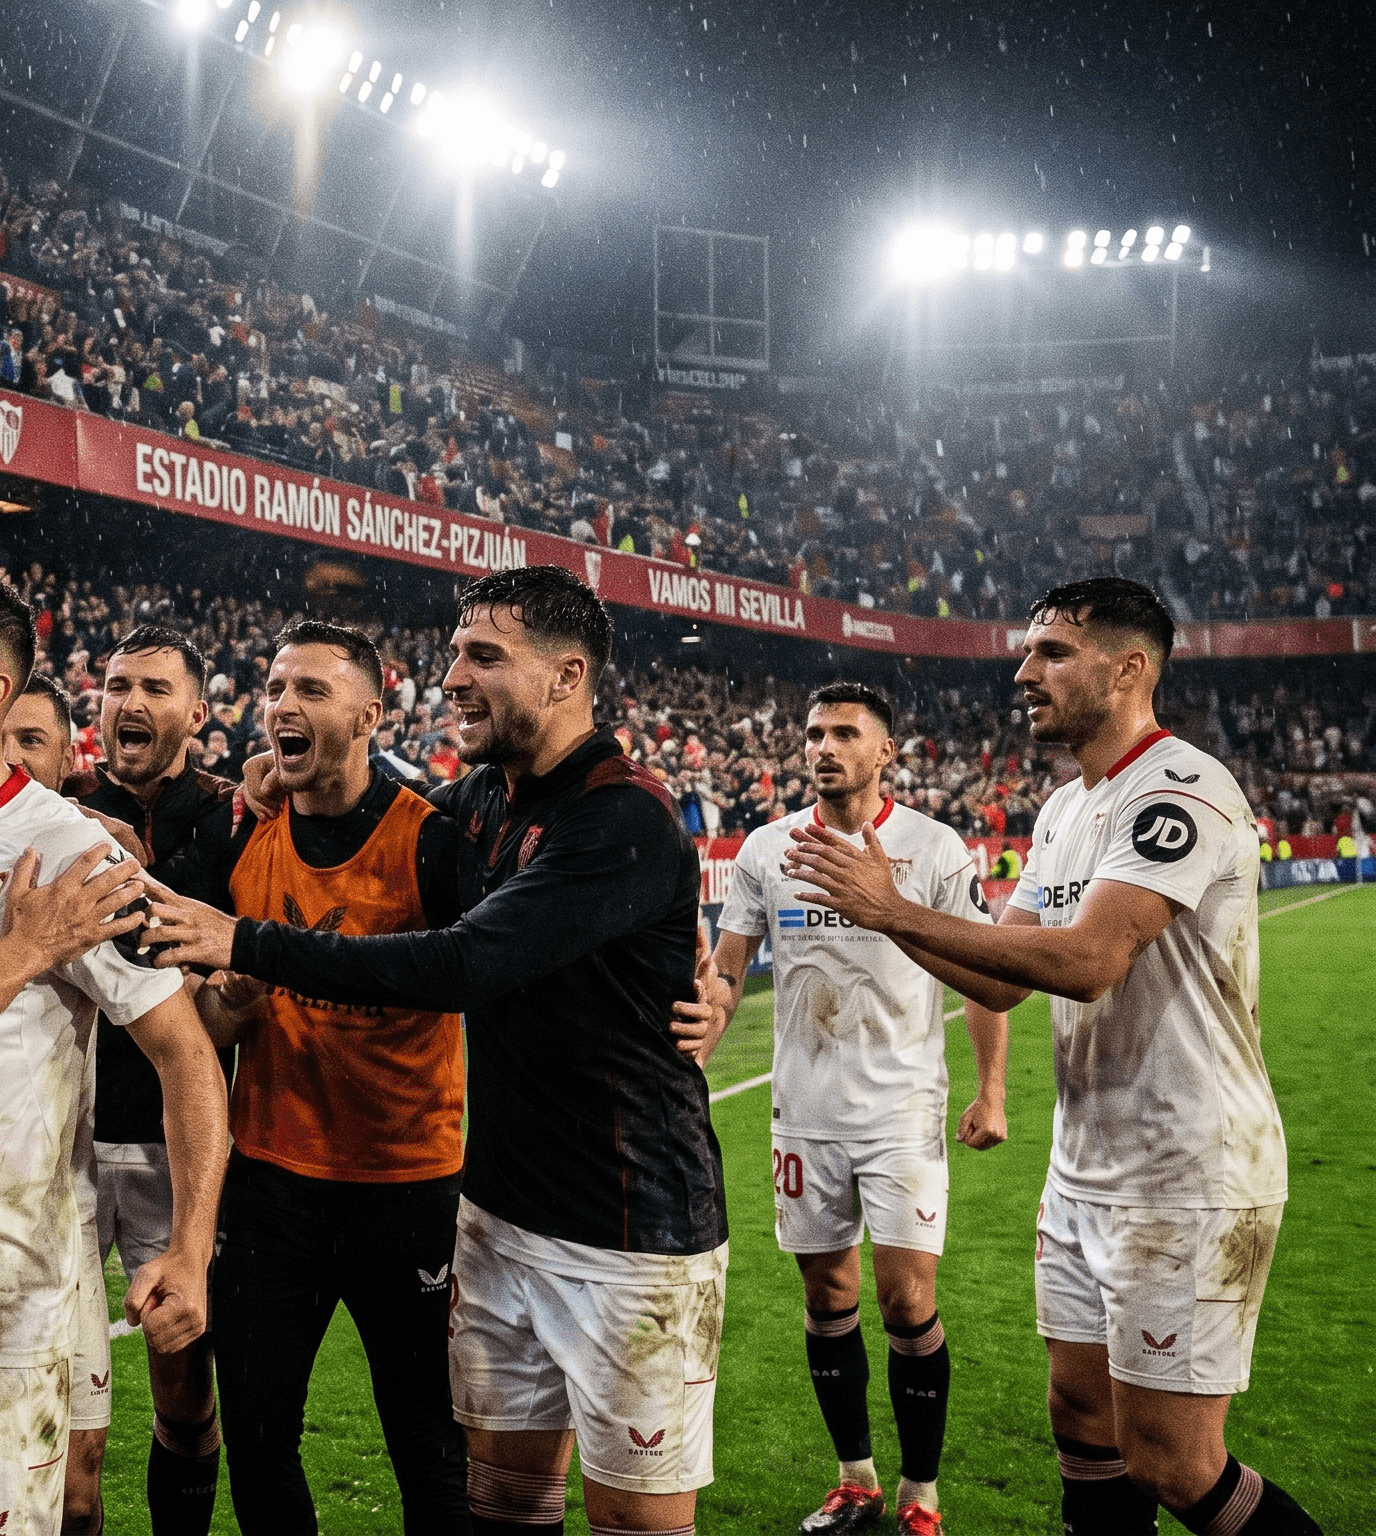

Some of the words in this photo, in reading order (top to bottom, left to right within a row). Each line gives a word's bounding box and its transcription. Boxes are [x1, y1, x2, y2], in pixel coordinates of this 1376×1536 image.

[135, 442, 247, 516] ESTADIO
[254, 477, 341, 537] RAMÓN
[347, 492, 526, 572] SÁNCHEZ-PIZJUÁN
[648, 568, 711, 613] VAMOS
[715, 582, 735, 617] MI
[739, 587, 806, 630] SEVILLA
[1136, 815, 1189, 849] JD
[773, 1148, 804, 1199] 20
